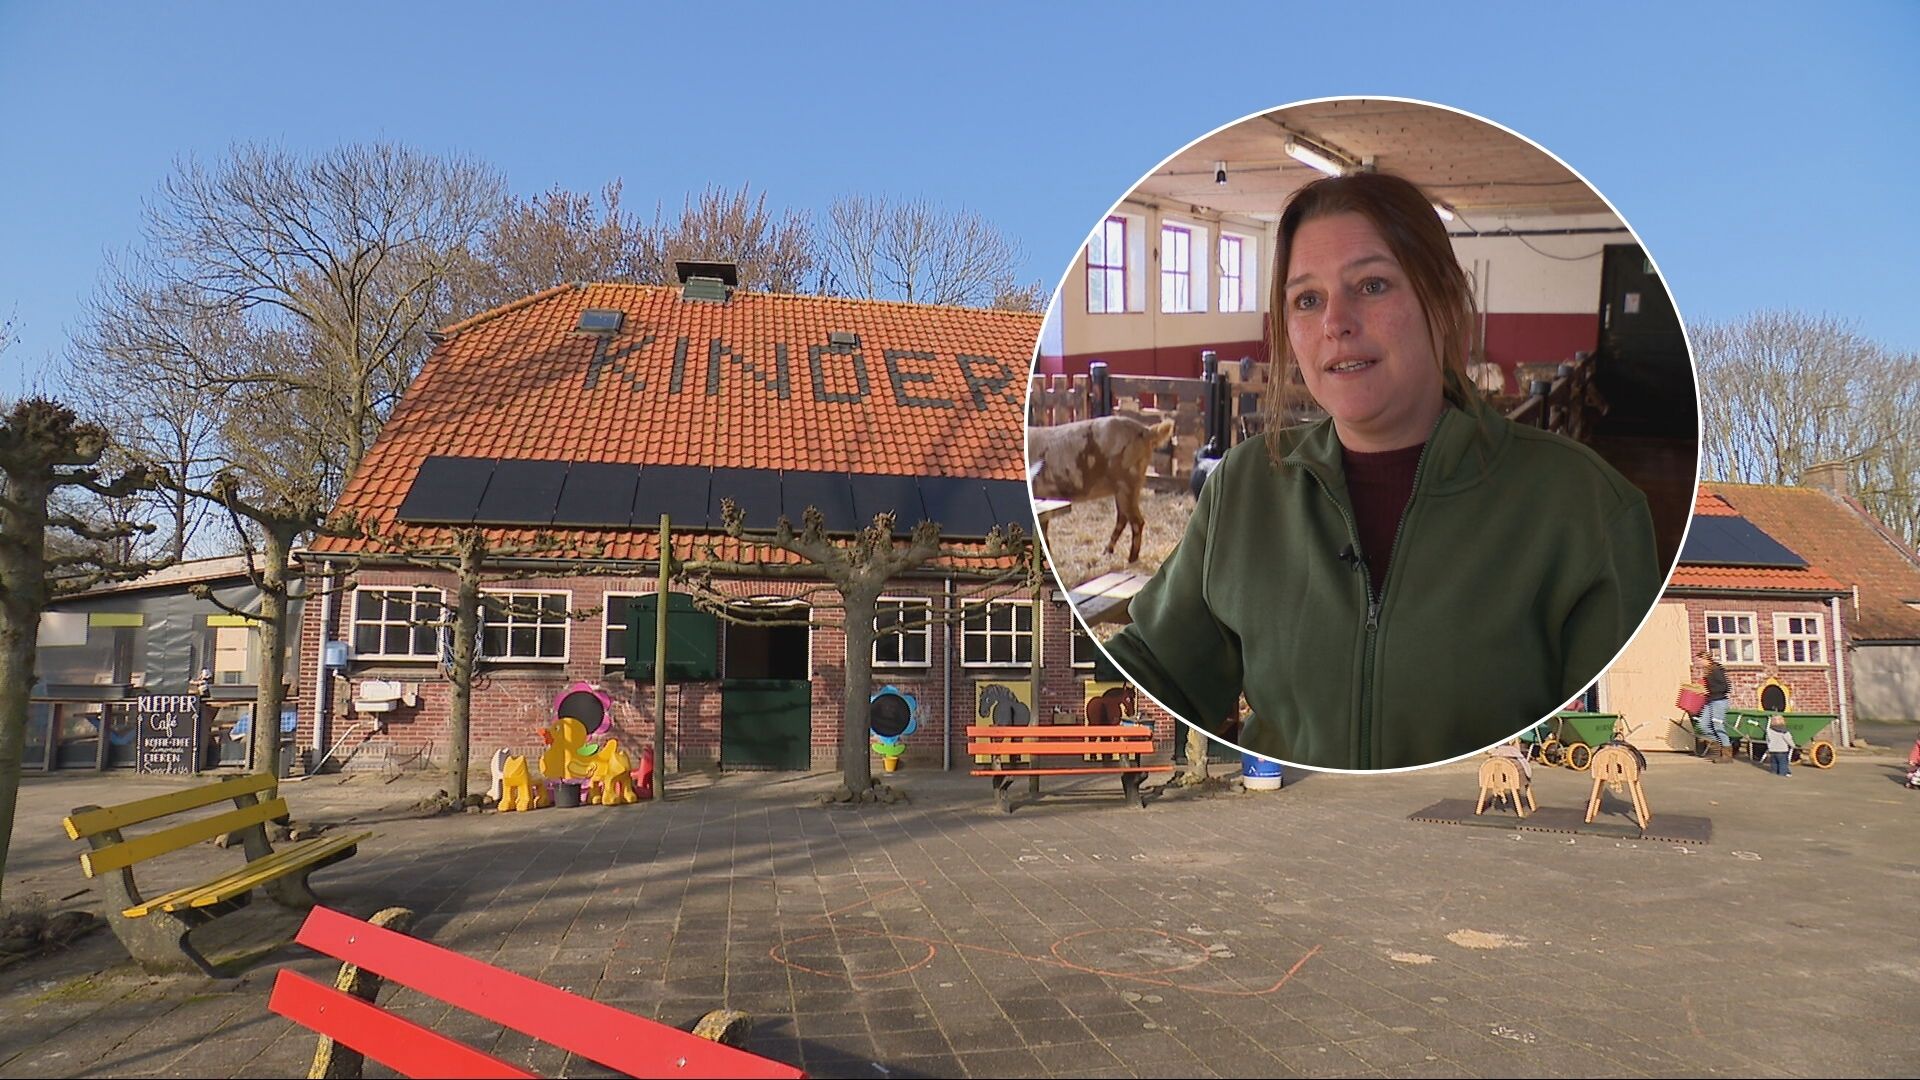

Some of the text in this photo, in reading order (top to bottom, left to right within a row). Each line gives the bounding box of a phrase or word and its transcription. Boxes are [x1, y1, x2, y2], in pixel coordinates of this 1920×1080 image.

[137, 695, 197, 713] KLEPPER
[150, 712, 177, 738] Café
[143, 752, 181, 763] EIEREN
